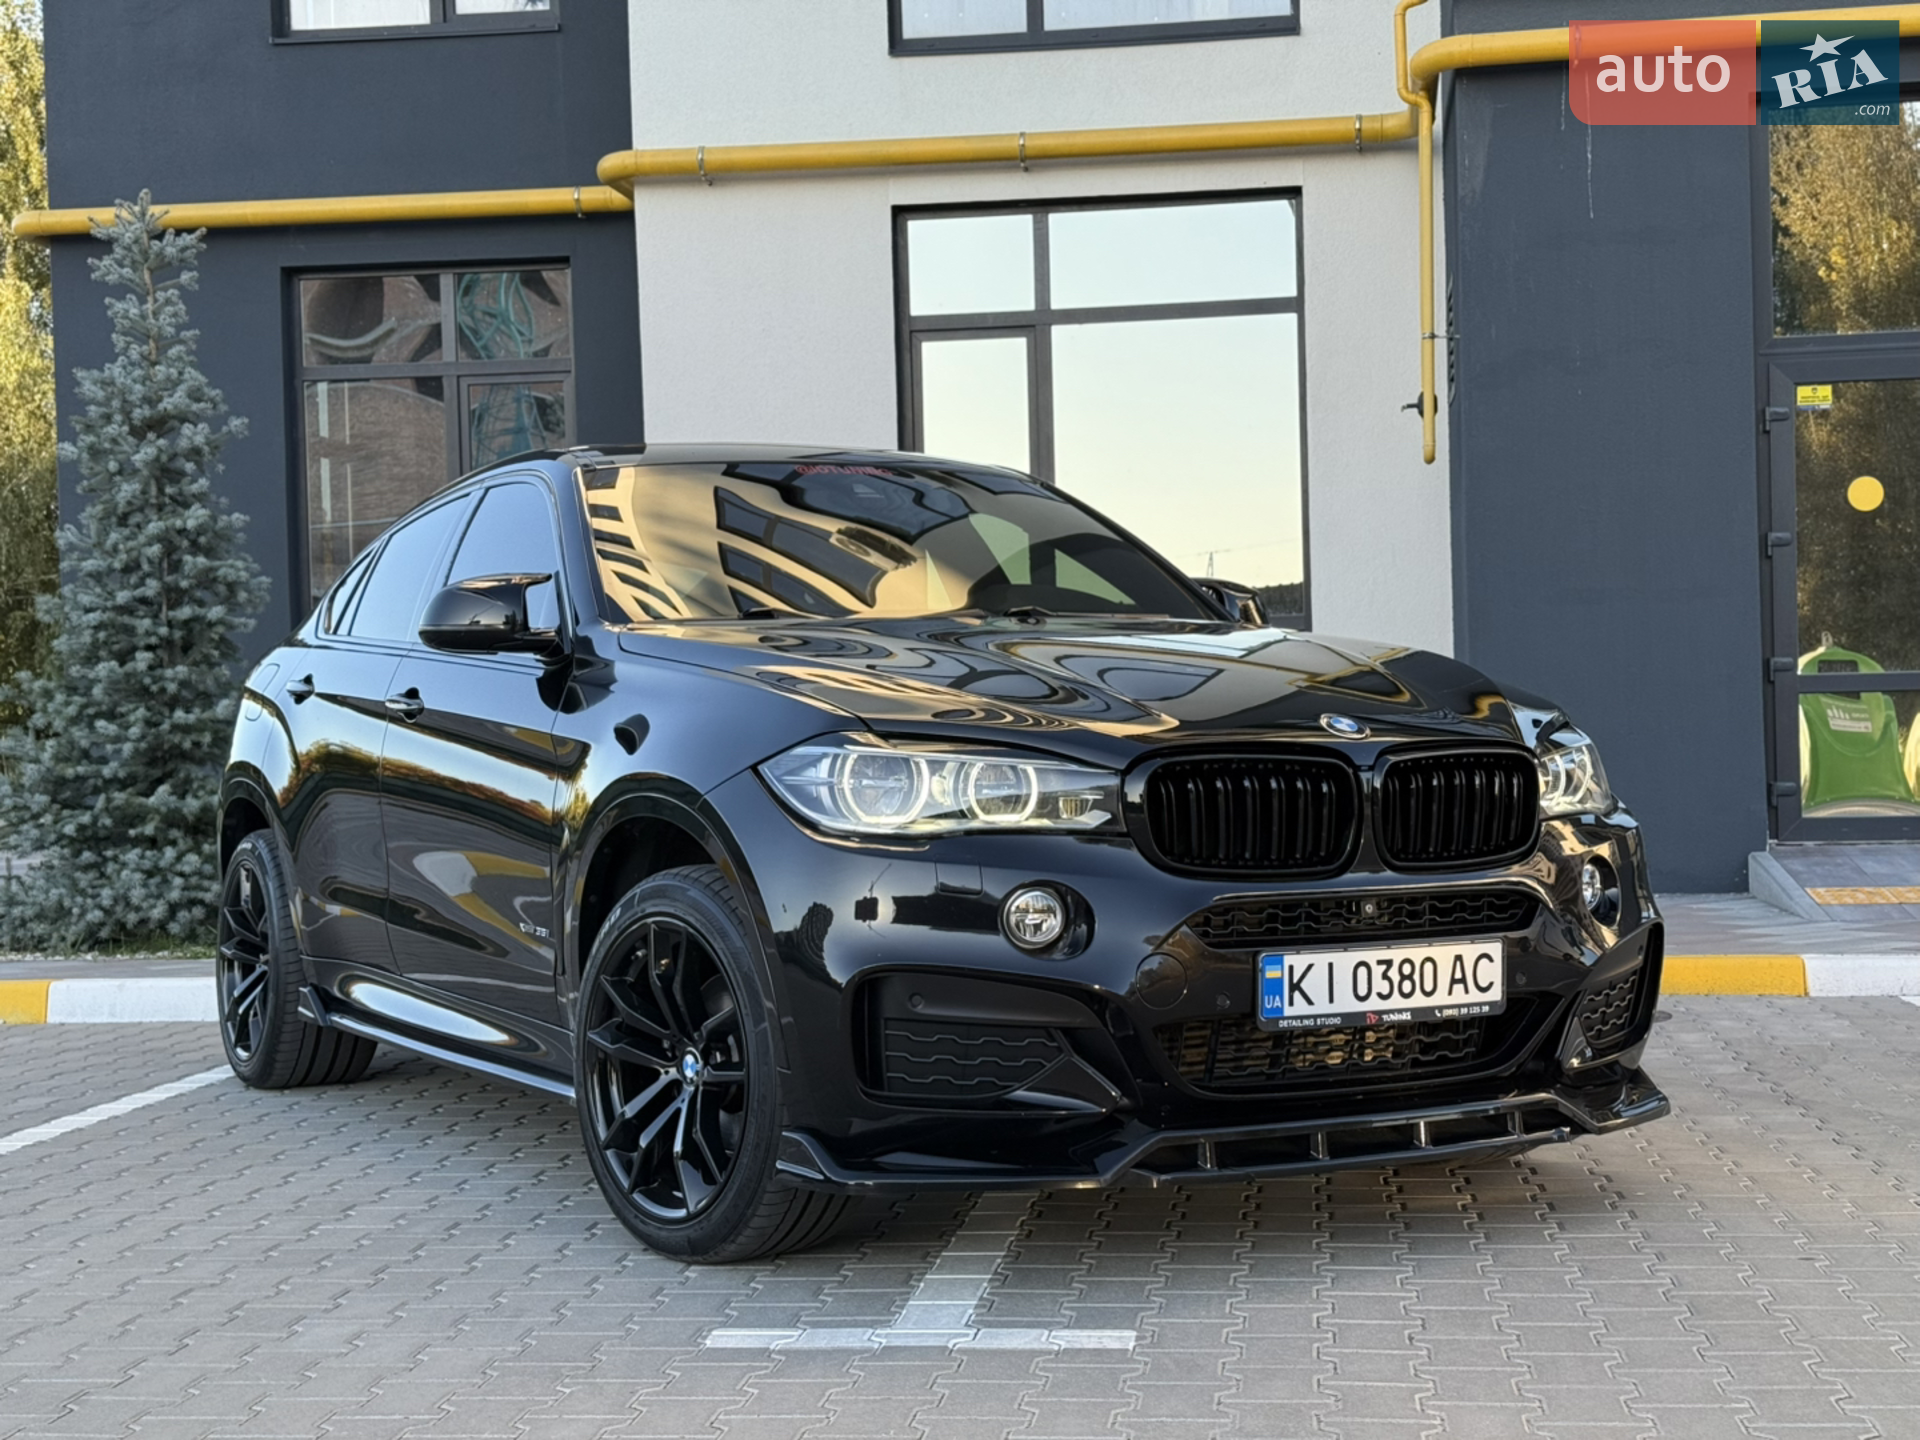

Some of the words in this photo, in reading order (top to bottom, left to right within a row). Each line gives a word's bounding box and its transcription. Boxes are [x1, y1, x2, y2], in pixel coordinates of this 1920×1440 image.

[1287, 962, 1335, 1007] KI
[1352, 956, 1438, 1003] 0380
[1447, 952, 1495, 997] AC
[1264, 995, 1282, 1009] UA
[1278, 1018, 1315, 1028] DETAILING
[1316, 1016, 1342, 1026] STUDIO
